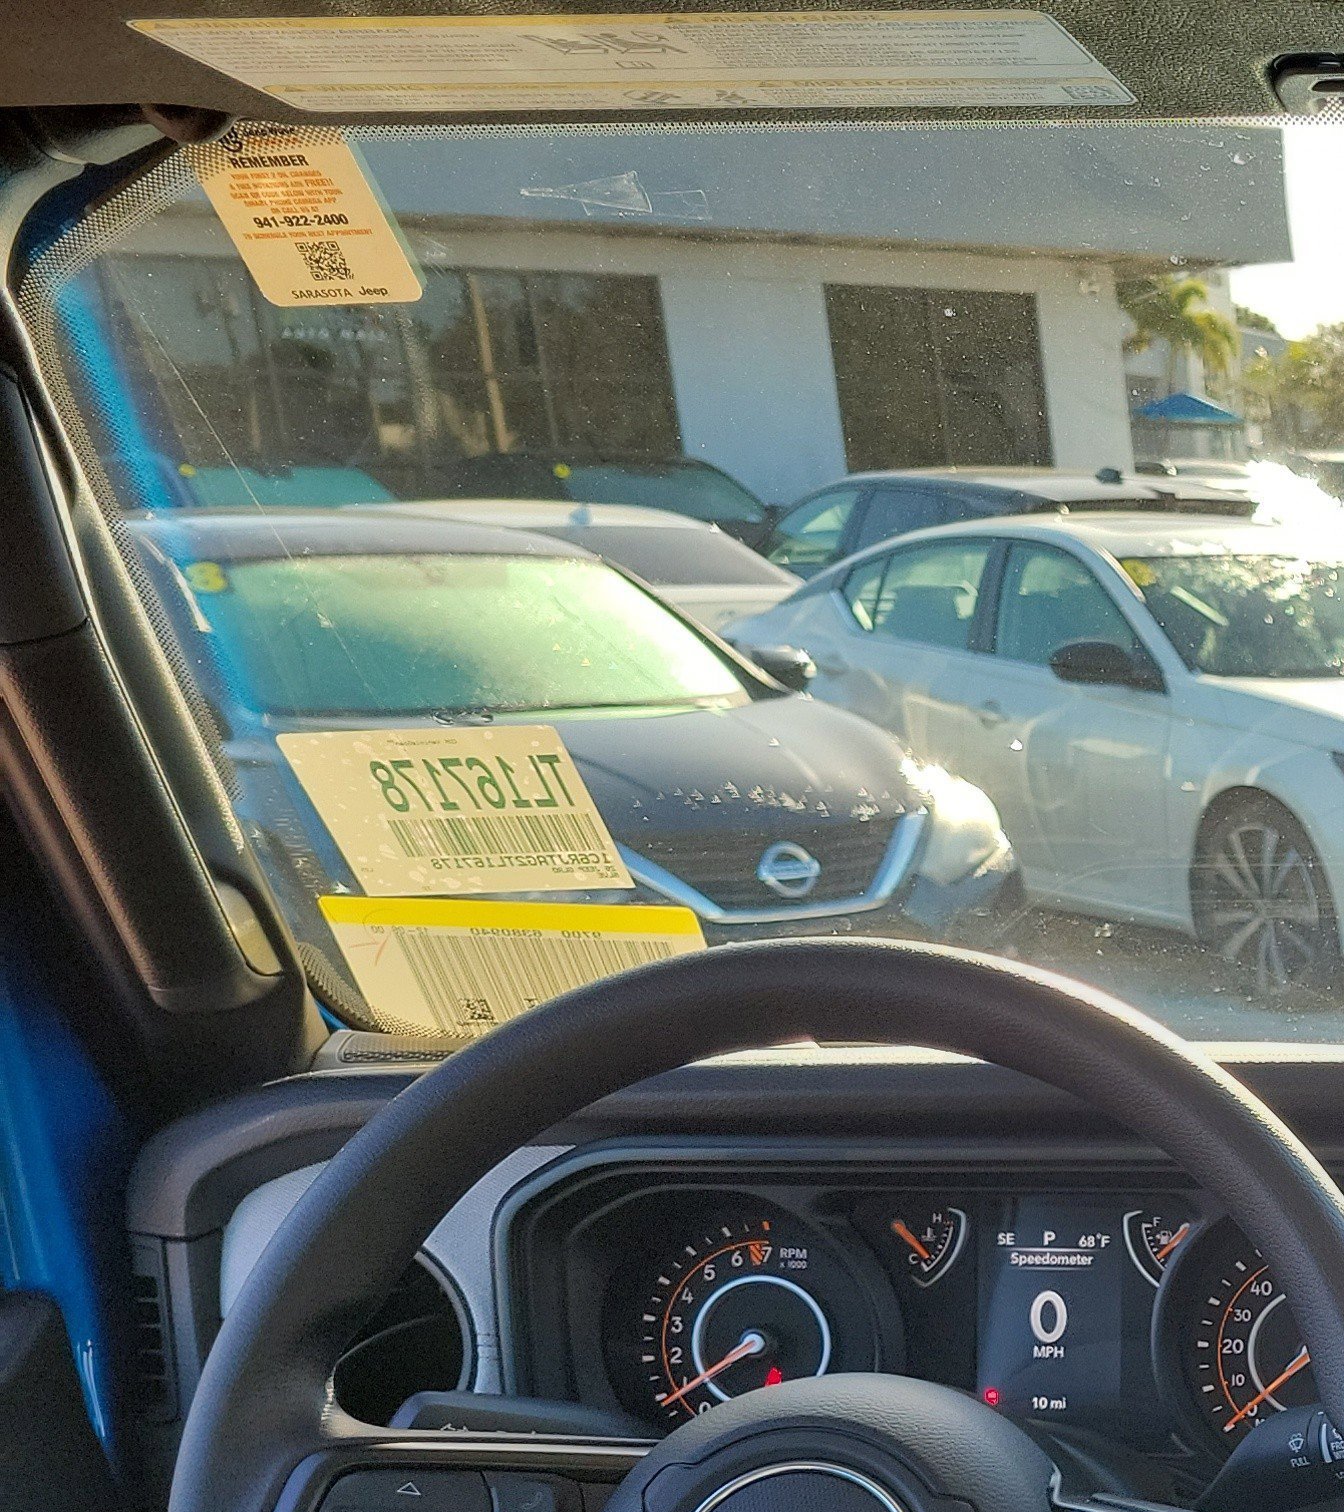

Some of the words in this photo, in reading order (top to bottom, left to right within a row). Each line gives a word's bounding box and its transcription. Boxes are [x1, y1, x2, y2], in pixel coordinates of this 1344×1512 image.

[230, 155, 309, 169] REMEMBER
[253, 213, 349, 228] 941-922-2400
[292, 288, 353, 299] SARASOTA
[358, 286, 389, 297] Jeep
[932, 1213, 942, 1223] H
[1153, 1217, 1162, 1227] F
[997, 1232, 1015, 1246] SE
[1043, 1231, 1056, 1246] P
[1078, 1232, 1111, 1248] 68°F
[731, 1250, 744, 1267] 6
[762, 1246, 773, 1263] 7
[779, 1248, 808, 1259] RPM
[1010, 1253, 1094, 1266] Speedometer
[703, 1264, 716, 1281] 5
[1250, 1280, 1273, 1296] 40
[681, 1288, 694, 1304] 4
[1030, 1290, 1068, 1344] 0
[1234, 1309, 1252, 1322] 30
[671, 1316, 683, 1334] 3
[1033, 1346, 1065, 1359] MPH
[1222, 1339, 1244, 1355] 20
[670, 1347, 683, 1364] 2
[1231, 1374, 1245, 1387] 10
[1032, 1397, 1048, 1410] 10
[1050, 1397, 1067, 1409] mi
